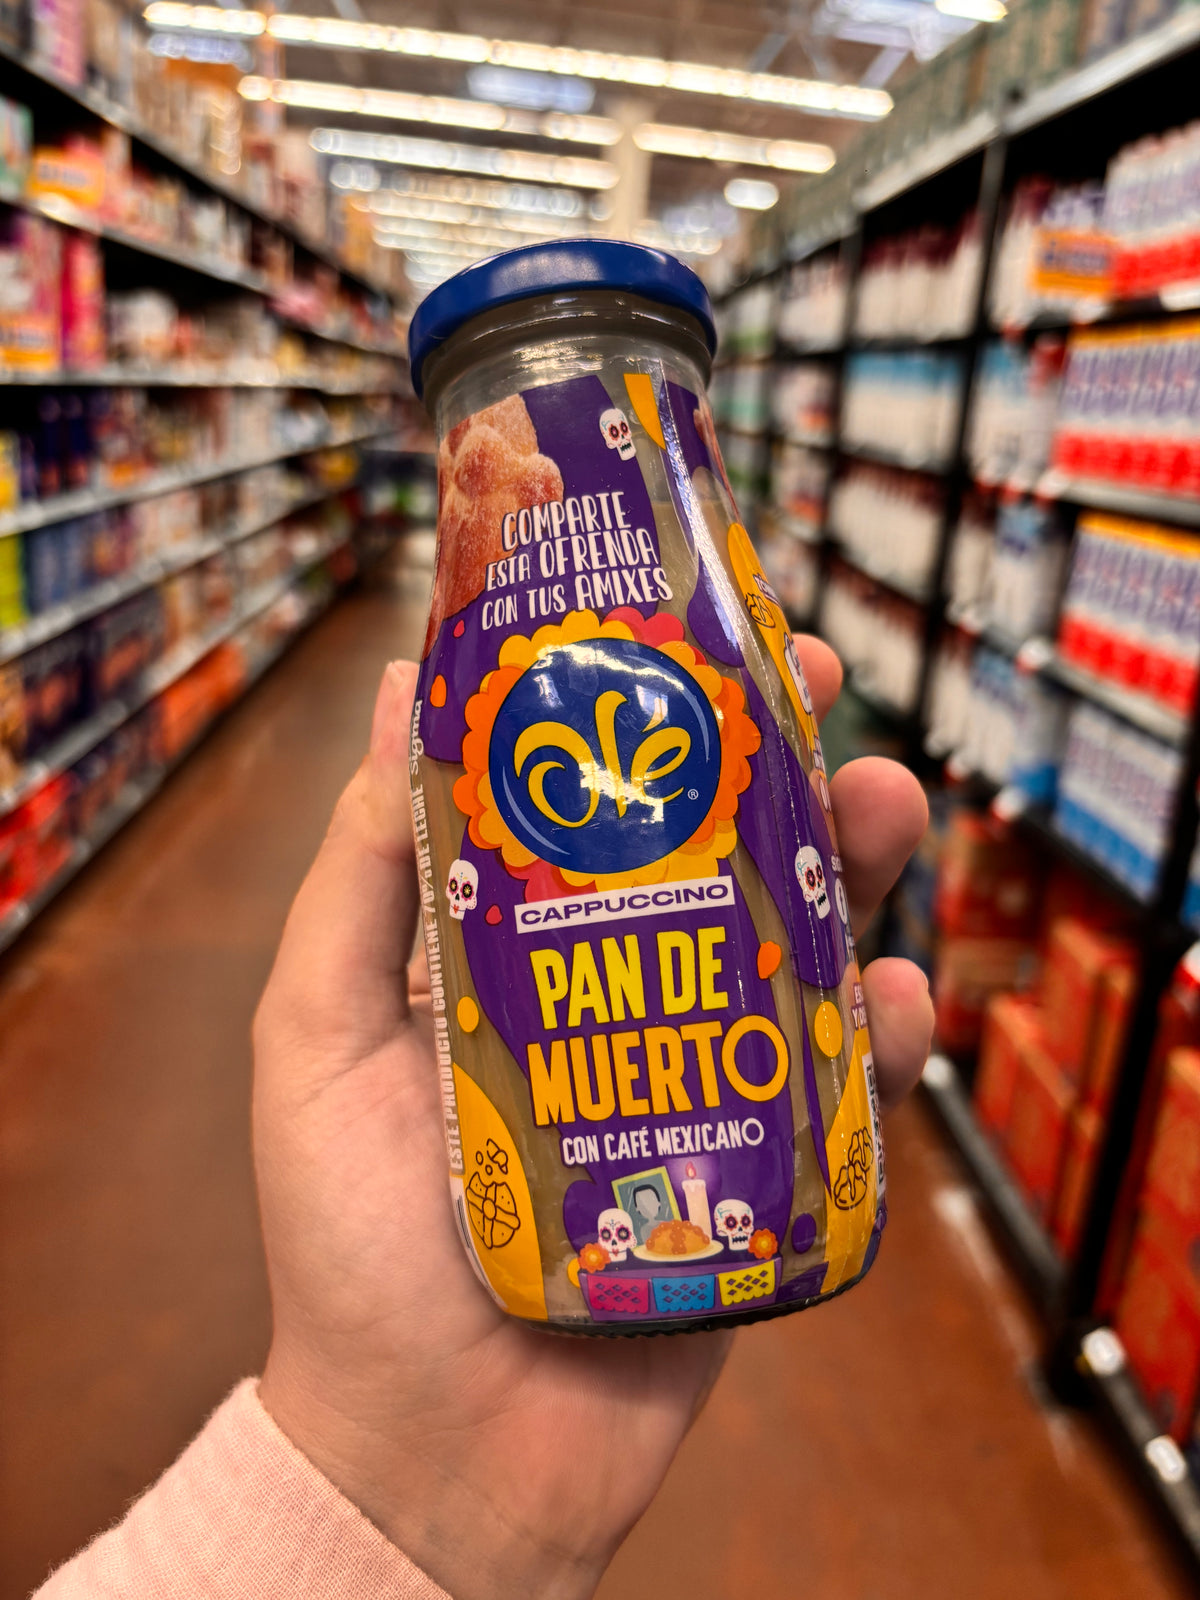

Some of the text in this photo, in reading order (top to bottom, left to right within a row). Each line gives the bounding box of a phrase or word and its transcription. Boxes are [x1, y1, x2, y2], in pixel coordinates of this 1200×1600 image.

[502, 491, 632, 551] COMPARTE
[485, 528, 660, 592] ESTA OFRENDA
[481, 567, 674, 631] CON TUS AMIXES
[412, 784, 428, 840] LECHE
[519, 883, 729, 925] CAPPUCCINO
[425, 919, 446, 1011] CONTIENE
[529, 925, 729, 1030] PAN DE
[436, 1016, 457, 1120] PRODUCTO
[526, 1014, 790, 1127] MUERTO
[446, 1125, 463, 1170] ESTE
[562, 1117, 765, 1166] CON CAFÉ MEXICANO
